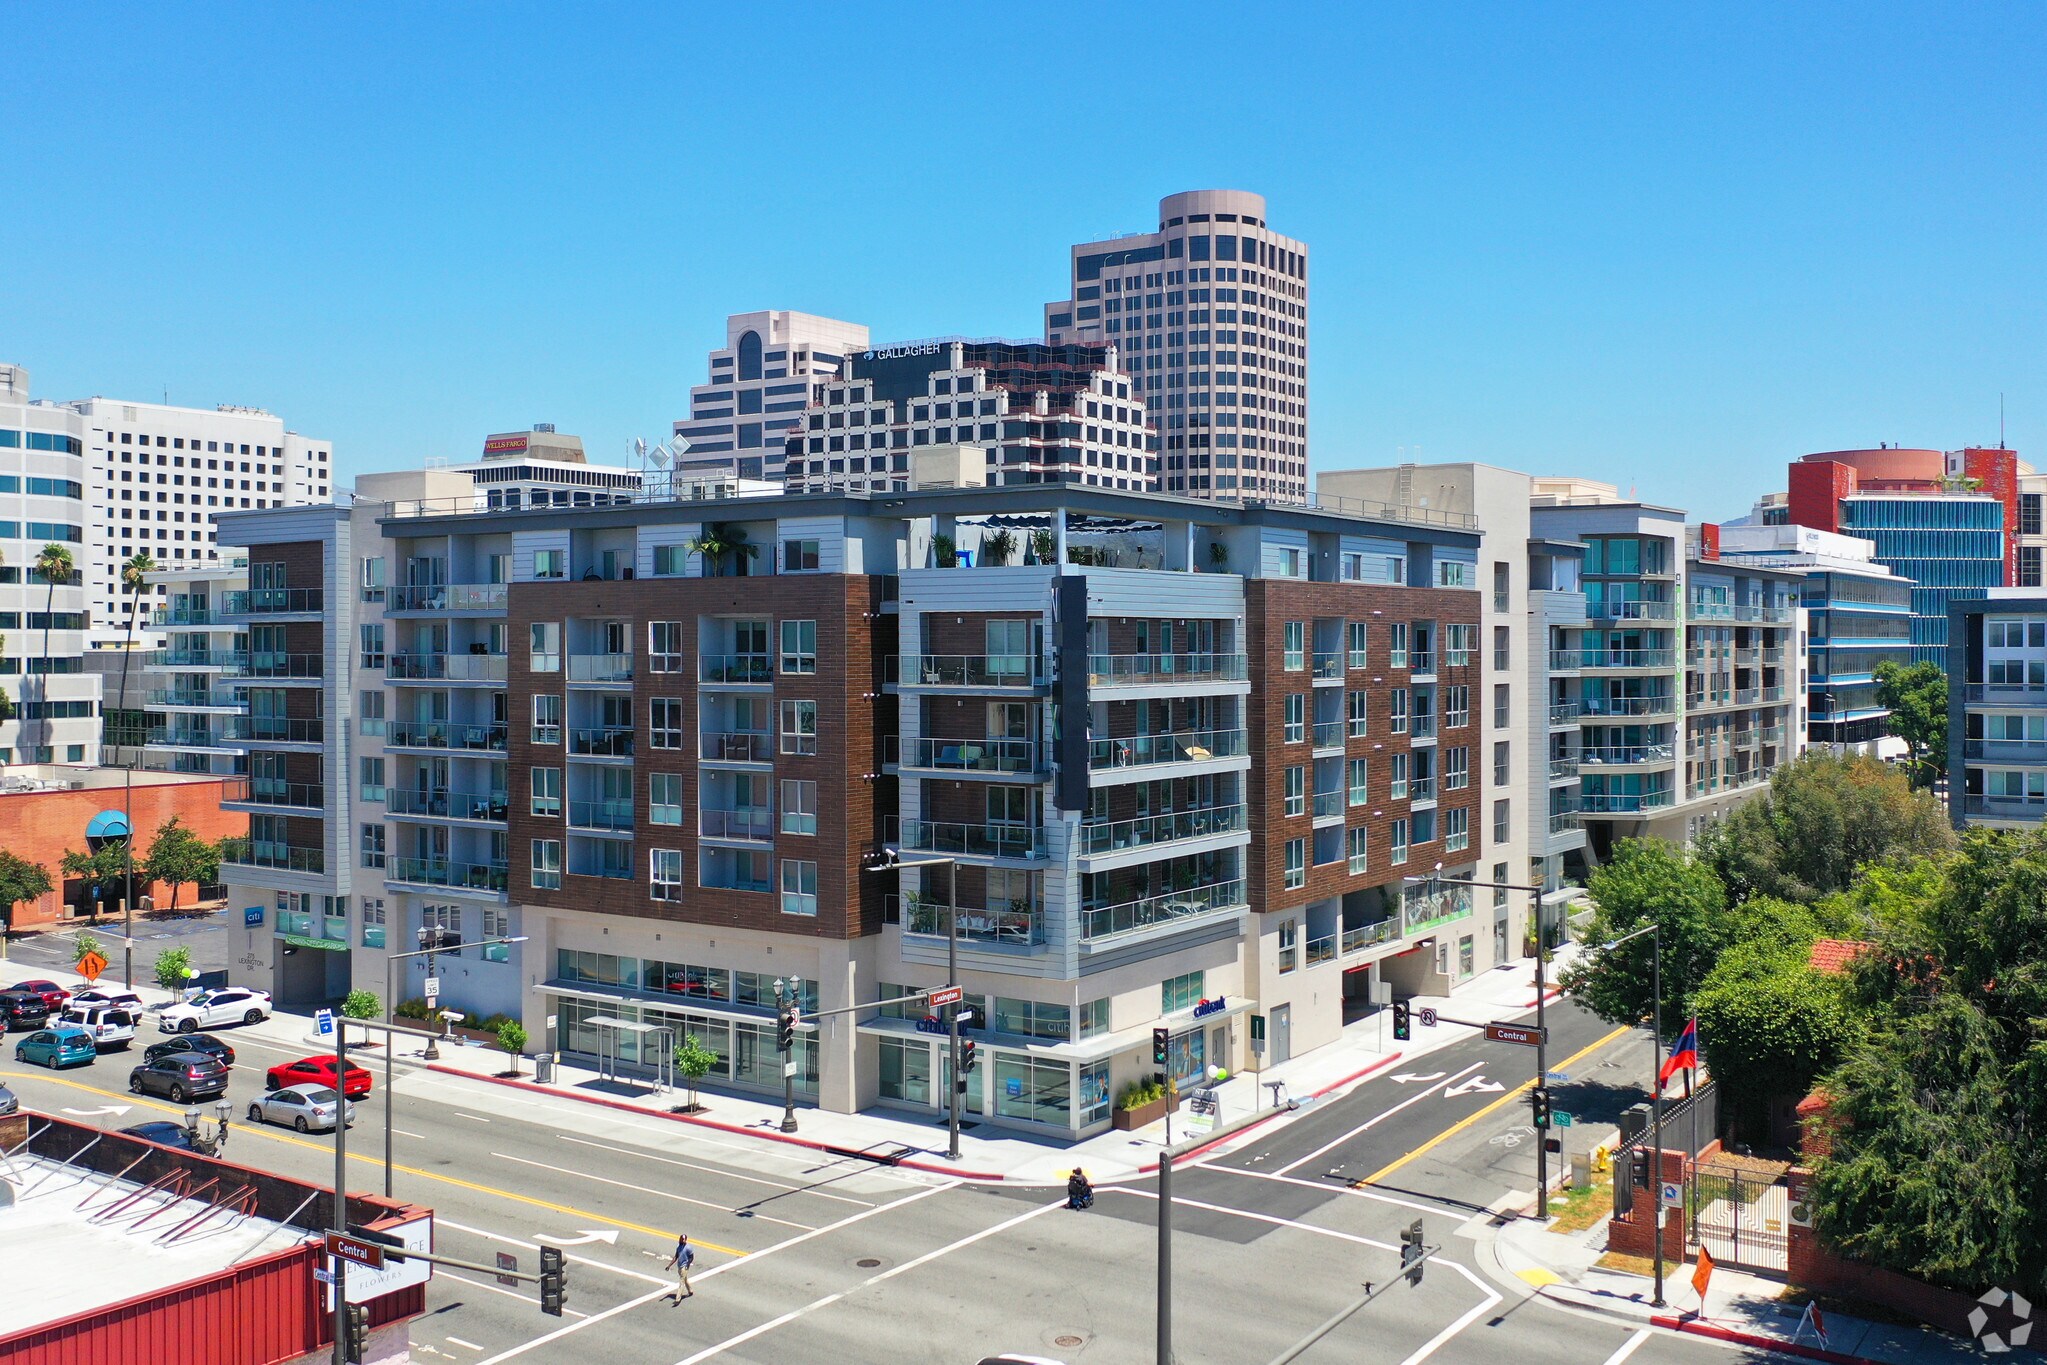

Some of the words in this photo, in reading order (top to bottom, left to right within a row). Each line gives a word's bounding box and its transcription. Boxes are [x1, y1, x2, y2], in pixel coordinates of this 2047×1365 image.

[877, 344, 941, 360] GALLAGHER
[486, 441, 506, 449] WELLS
[506, 440, 526, 448] FARGO
[247, 912, 261, 921] citi
[427, 986, 438, 994] 35
[933, 992, 958, 1003] Lexington
[1497, 1030, 1527, 1041] Central
[337, 1241, 368, 1260] Central
[360, 1270, 402, 1290] FLOWERS
